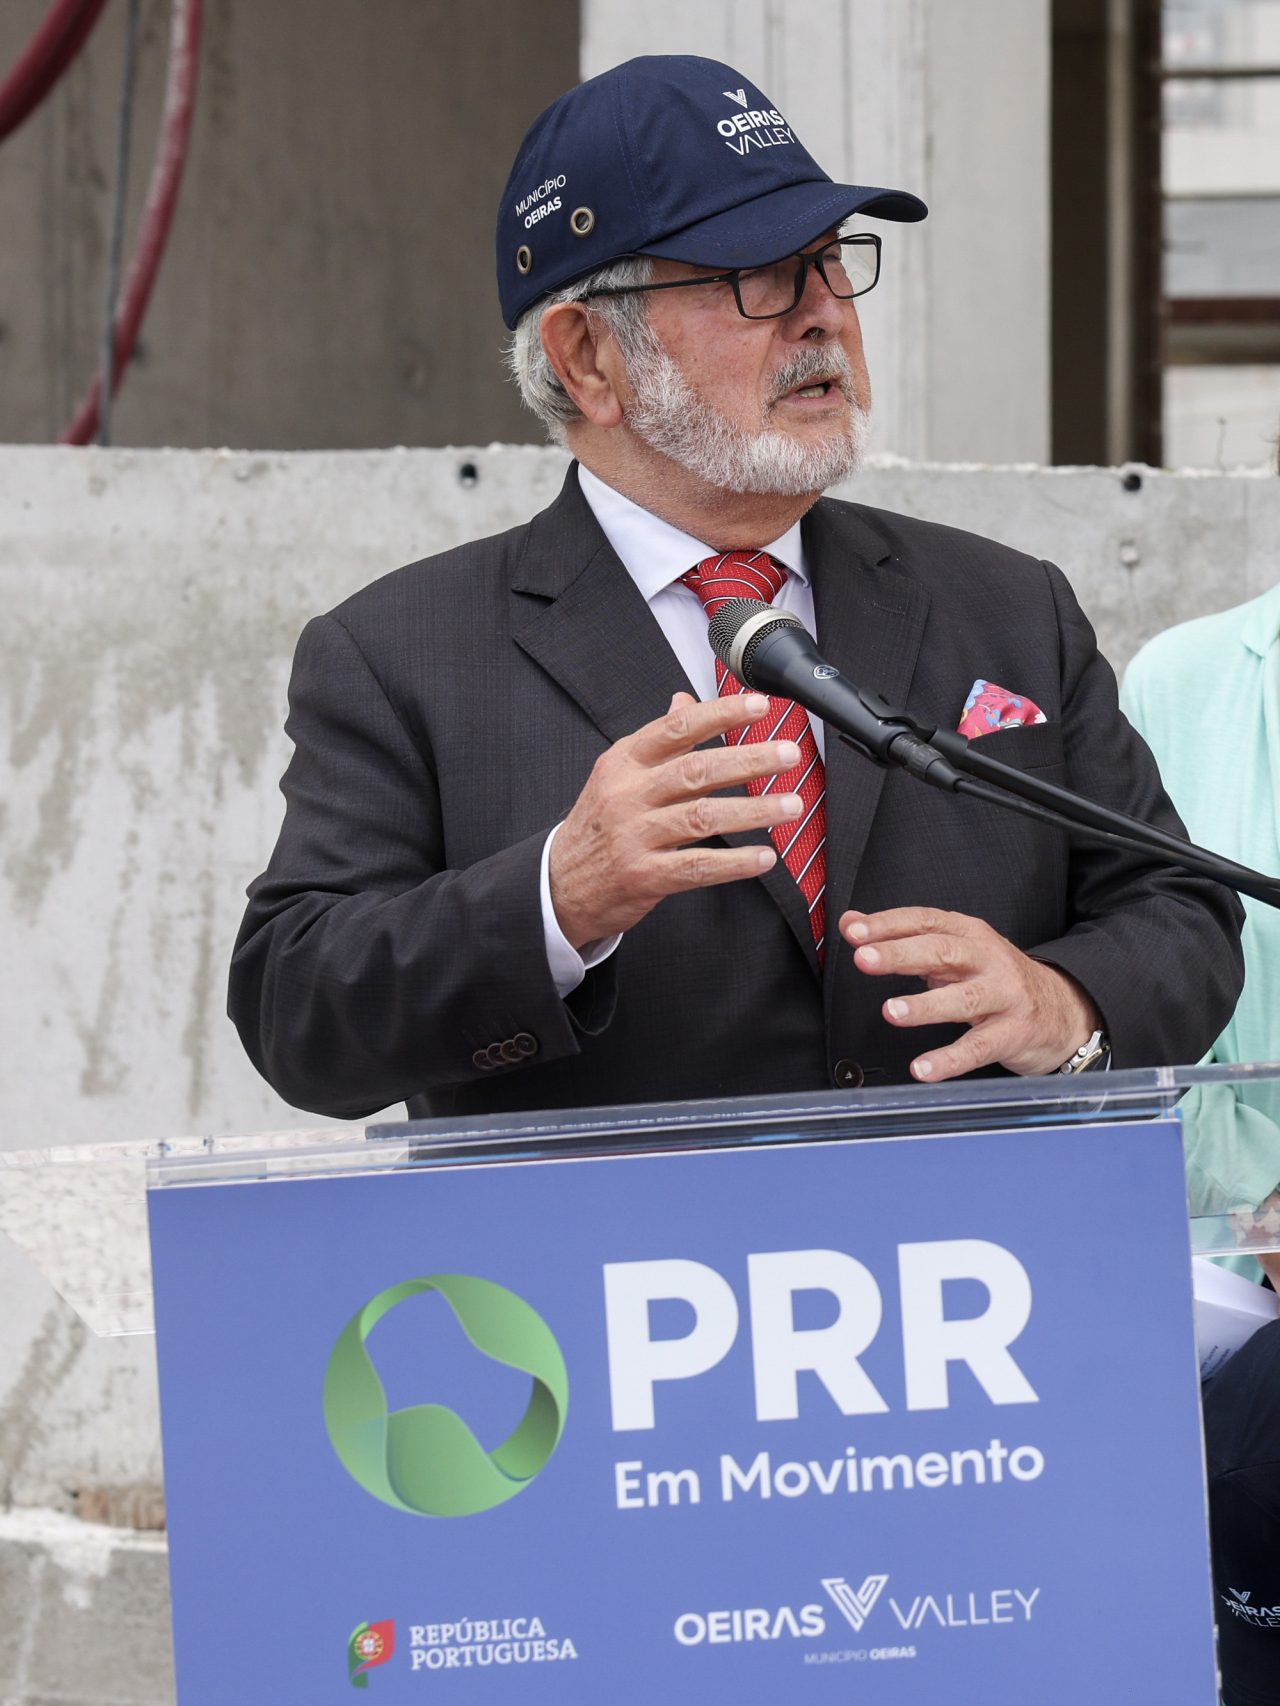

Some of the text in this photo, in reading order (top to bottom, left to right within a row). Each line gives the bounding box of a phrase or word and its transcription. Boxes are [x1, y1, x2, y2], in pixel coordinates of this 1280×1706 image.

[717, 109, 784, 138] OEIRAS
[725, 128, 795, 156] VALLEY
[515, 174, 567, 217] MUNICÍPIO
[524, 196, 563, 229] OEIRAS
[603, 1239, 1041, 1432] PRR
[614, 1439, 1045, 1509] Em Movimento
[409, 1617, 547, 1647] REPÚBLICA
[673, 1604, 825, 1646] OEIRAS
[889, 1588, 1041, 1630] VALLEY
[410, 1638, 579, 1671] PORTUGUESA
[869, 1645, 917, 1660] OEIRAS
